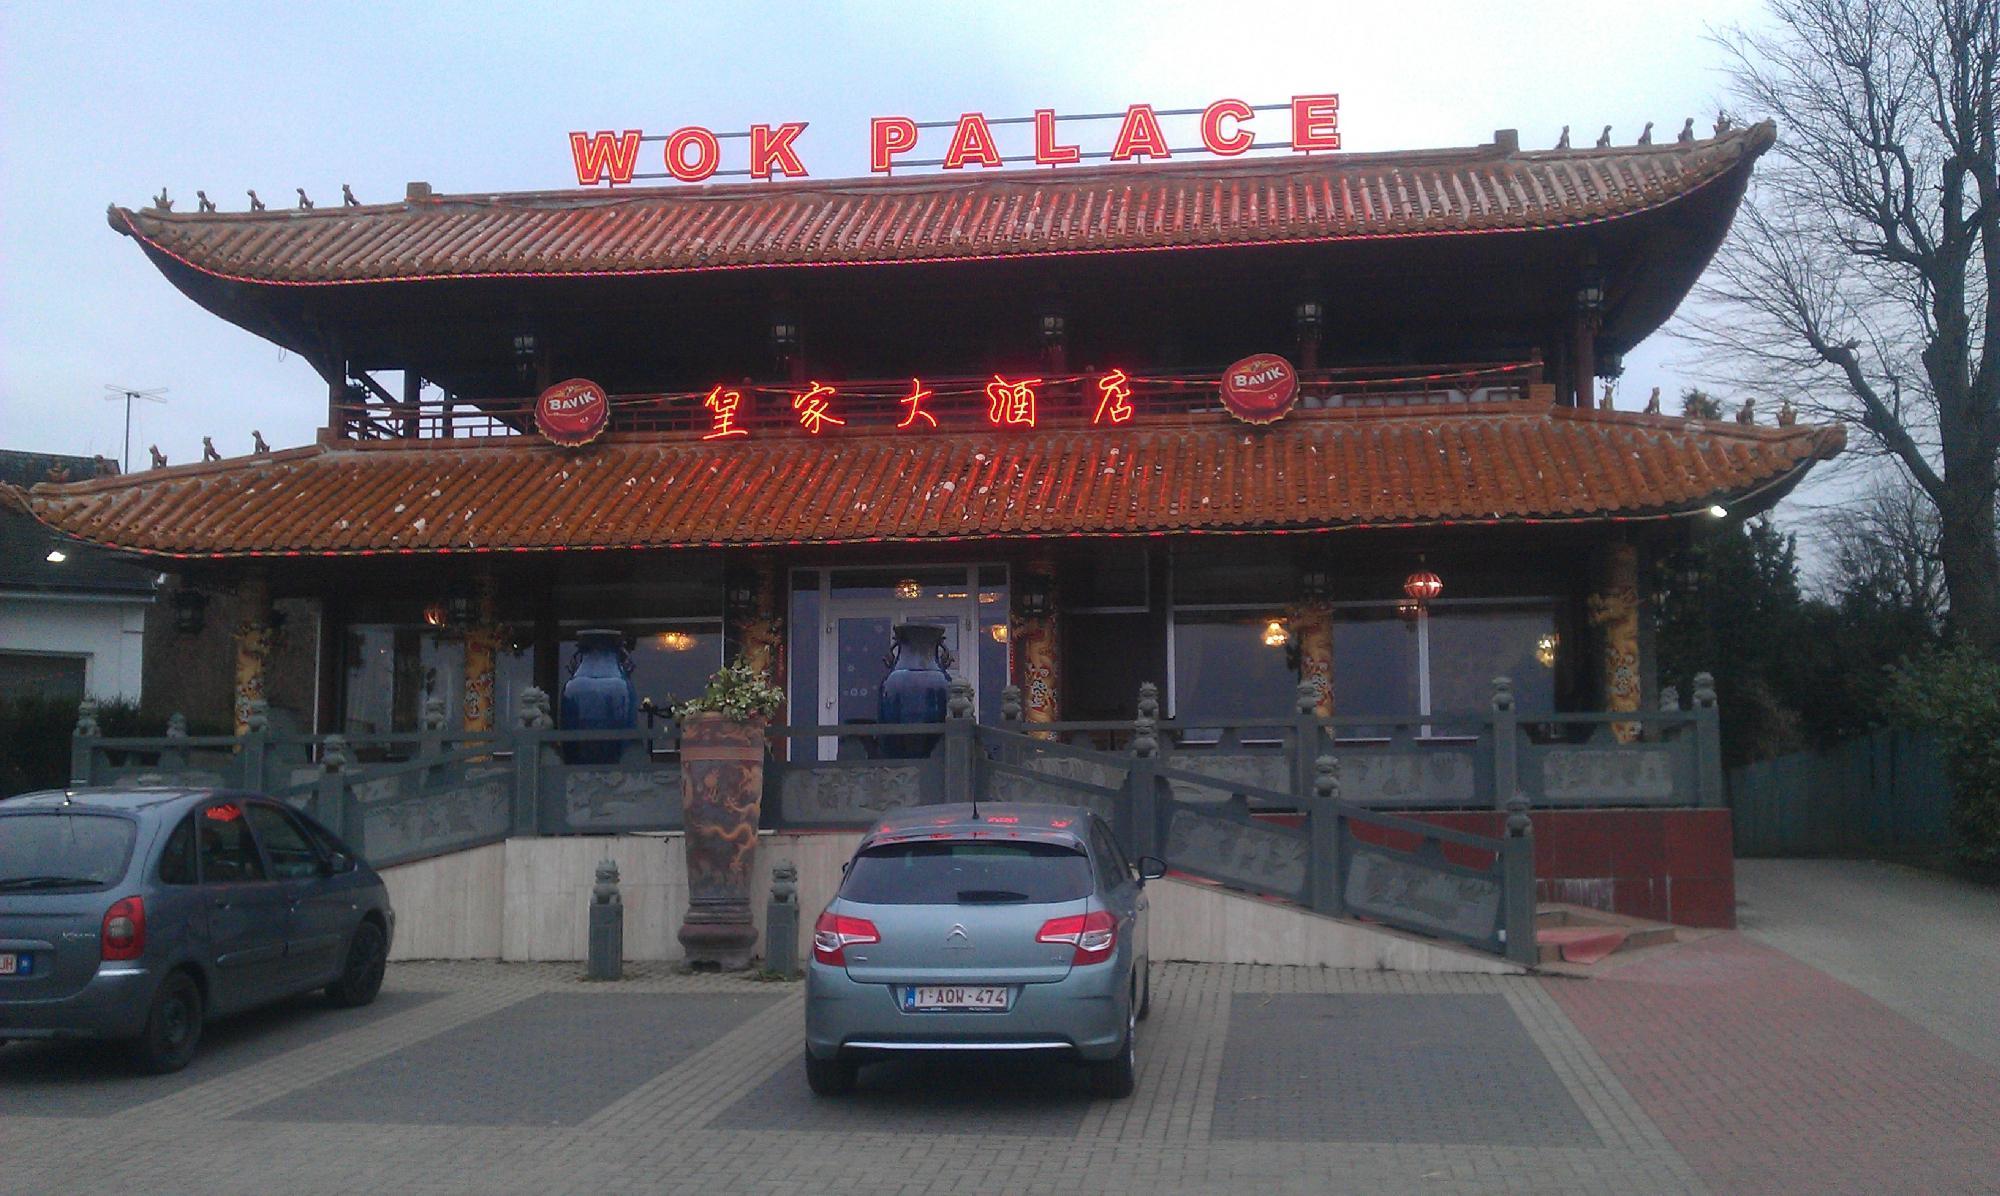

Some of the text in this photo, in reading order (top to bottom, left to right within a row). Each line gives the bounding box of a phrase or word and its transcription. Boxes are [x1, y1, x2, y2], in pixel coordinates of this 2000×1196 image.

[569, 93, 1341, 185] WOK PALACE
[1234, 367, 1285, 387] BAVIK
[548, 391, 596, 410] BAVIK
[703, 369, 1133, 439] 皇家大酒店
